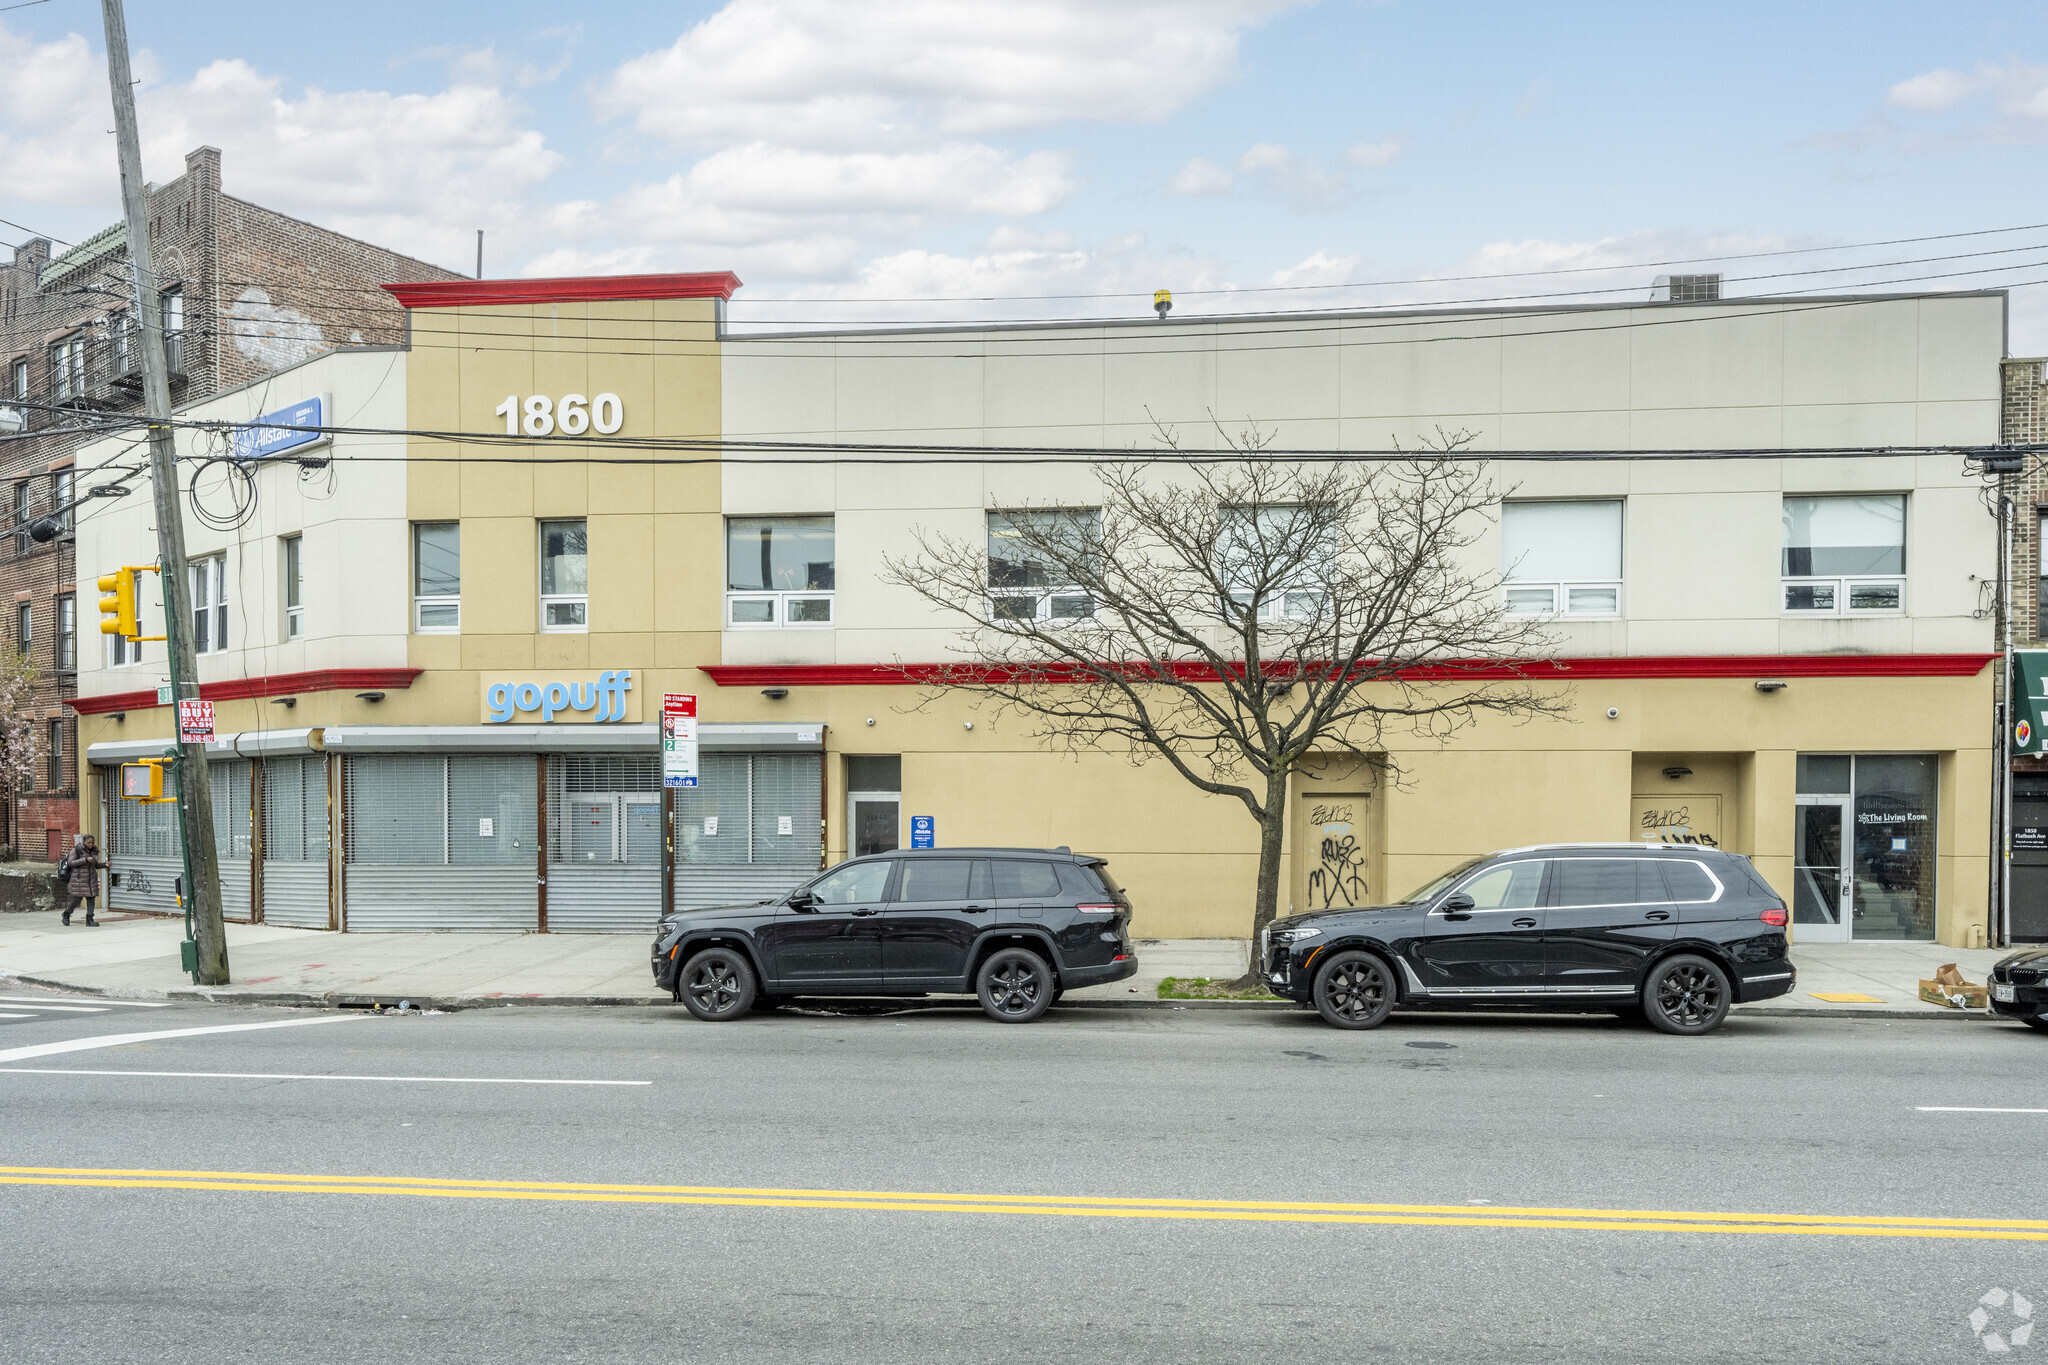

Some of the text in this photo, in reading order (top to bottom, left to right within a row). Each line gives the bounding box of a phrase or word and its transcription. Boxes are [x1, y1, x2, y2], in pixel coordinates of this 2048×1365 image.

[496, 393, 624, 436] 1860
[255, 422, 292, 447] Allstate
[487, 670, 632, 723] gopuff
[181, 708, 211, 717] BUY
[666, 740, 673, 751] 2
[1870, 813, 1928, 822] The Living Room
